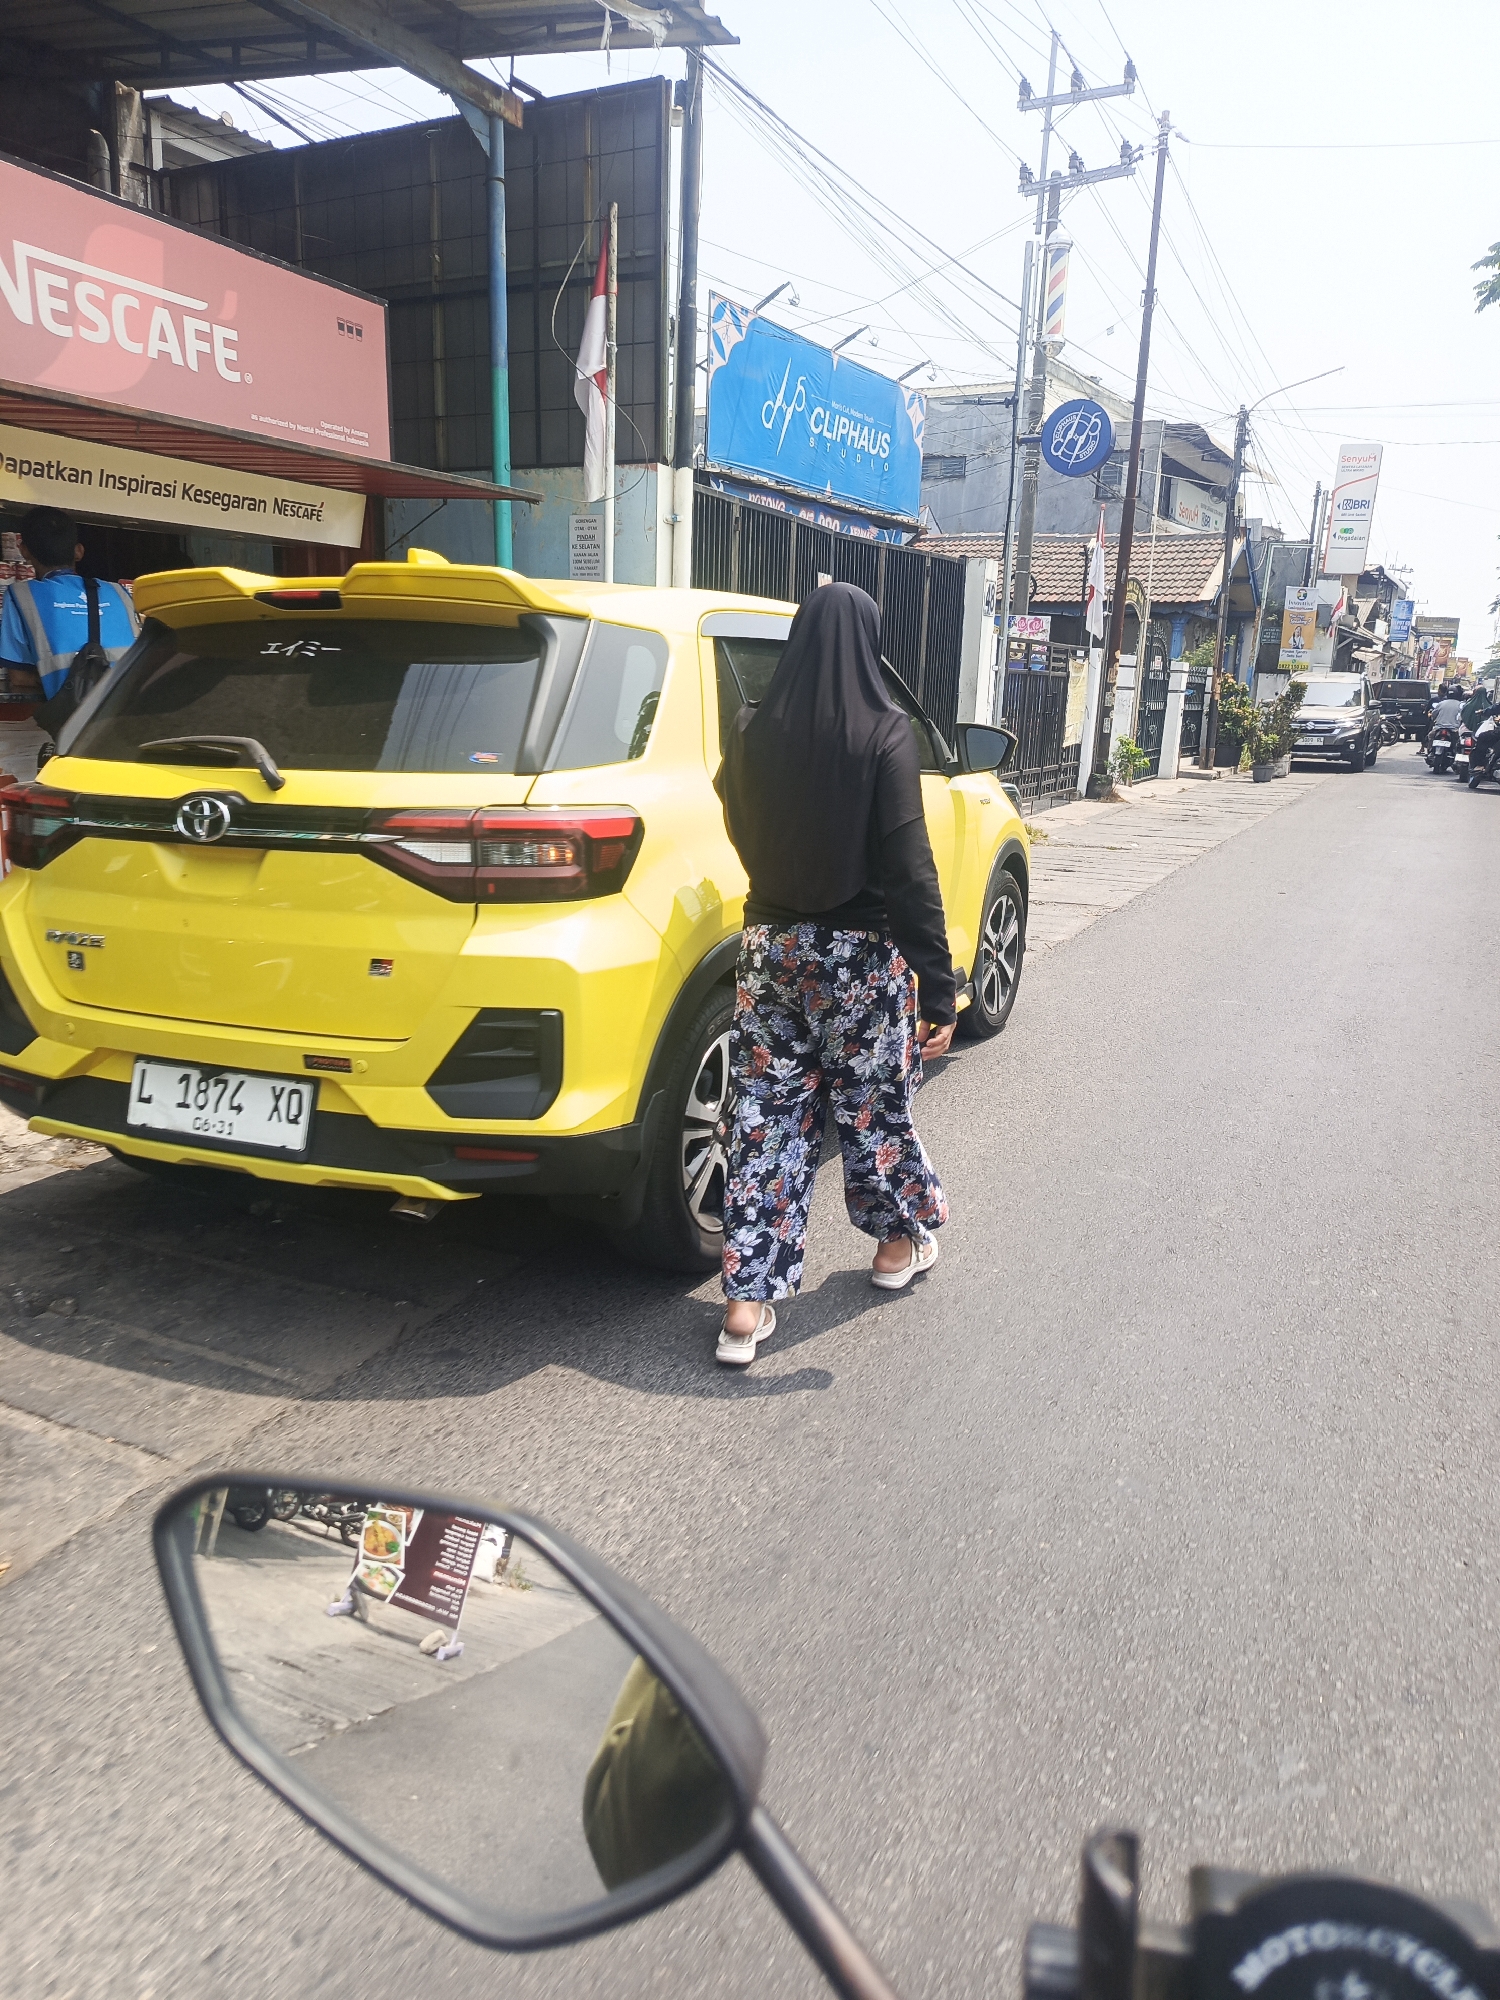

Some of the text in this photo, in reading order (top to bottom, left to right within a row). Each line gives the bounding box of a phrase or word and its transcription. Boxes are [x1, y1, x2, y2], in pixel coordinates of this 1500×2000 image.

[259, 415, 288, 428] authorized
[315, 428, 346, 442] Professional
[346, 436, 369, 447] Indonesia
[321, 420, 344, 433] Operated
[810, 406, 891, 459] CLIPHAUS
[1055, 415, 1077, 439] CLIPHAUS
[809, 436, 889, 472] STUDIO
[1079, 440, 1096, 459] STUDIO
[99, 469, 177, 498] Inspirasi
[181, 482, 267, 514] Kesegaran
[1353, 500, 1370, 510] BRI
[1337, 534, 1366, 542] Pegadaian
[985, 583, 996, 614] 48
[260, 640, 342, 657] エイミー
[137, 1069, 303, 1126] L 1874 XQ
